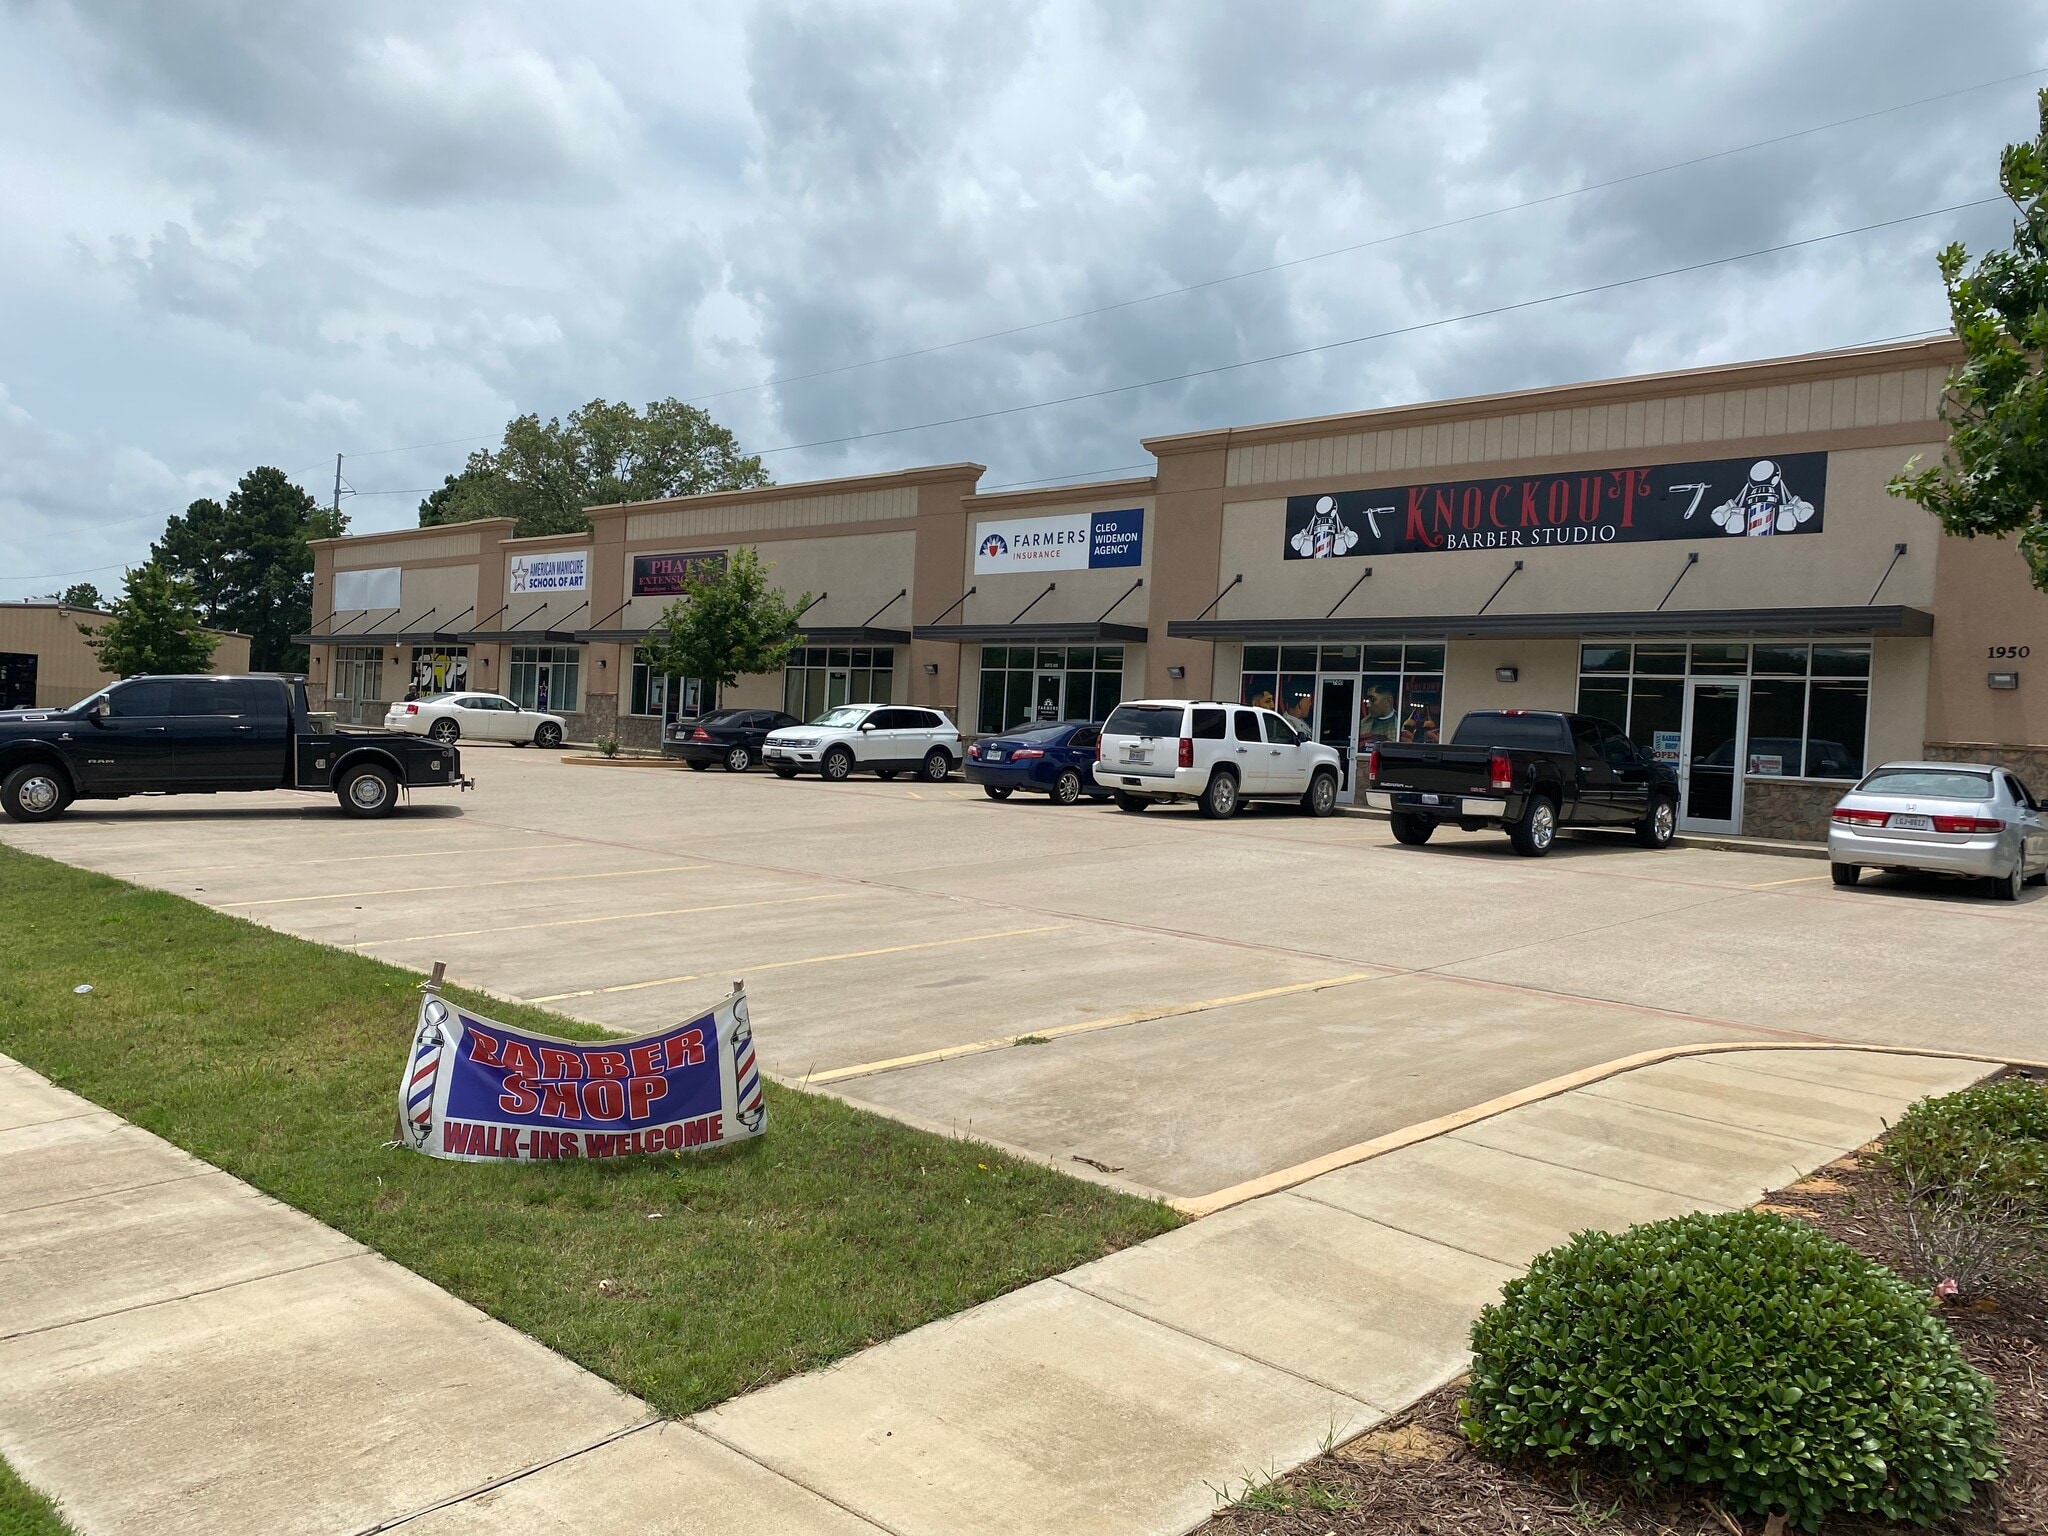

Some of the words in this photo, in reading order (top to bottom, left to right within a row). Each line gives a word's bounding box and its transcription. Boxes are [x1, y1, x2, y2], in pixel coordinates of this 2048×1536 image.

[1405, 468, 1651, 548] KNOCKOUT
[1095, 522, 1118, 533] CLEO
[1013, 529, 1086, 547] FARMERS
[1094, 532, 1138, 544] WIDEMON
[1447, 530, 1522, 549] BARBER
[1531, 524, 1616, 545] STUDIO
[1013, 550, 1061, 560] INSURANCE
[1094, 545, 1129, 555] AGENCY
[529, 561, 556, 577] AMERICAN
[556, 559, 584, 575] MANICURE
[529, 577, 557, 588] SCHOOL
[558, 576, 568, 587] OF
[568, 575, 584, 586] ART
[1987, 645, 2031, 659] 1950
[1654, 751, 1680, 760] OPEN
[468, 1028, 706, 1080] BARBER
[498, 1072, 669, 1121] SHOP
[443, 1121, 579, 1160] WALK-INS
[584, 1113, 725, 1159] WELCOME
